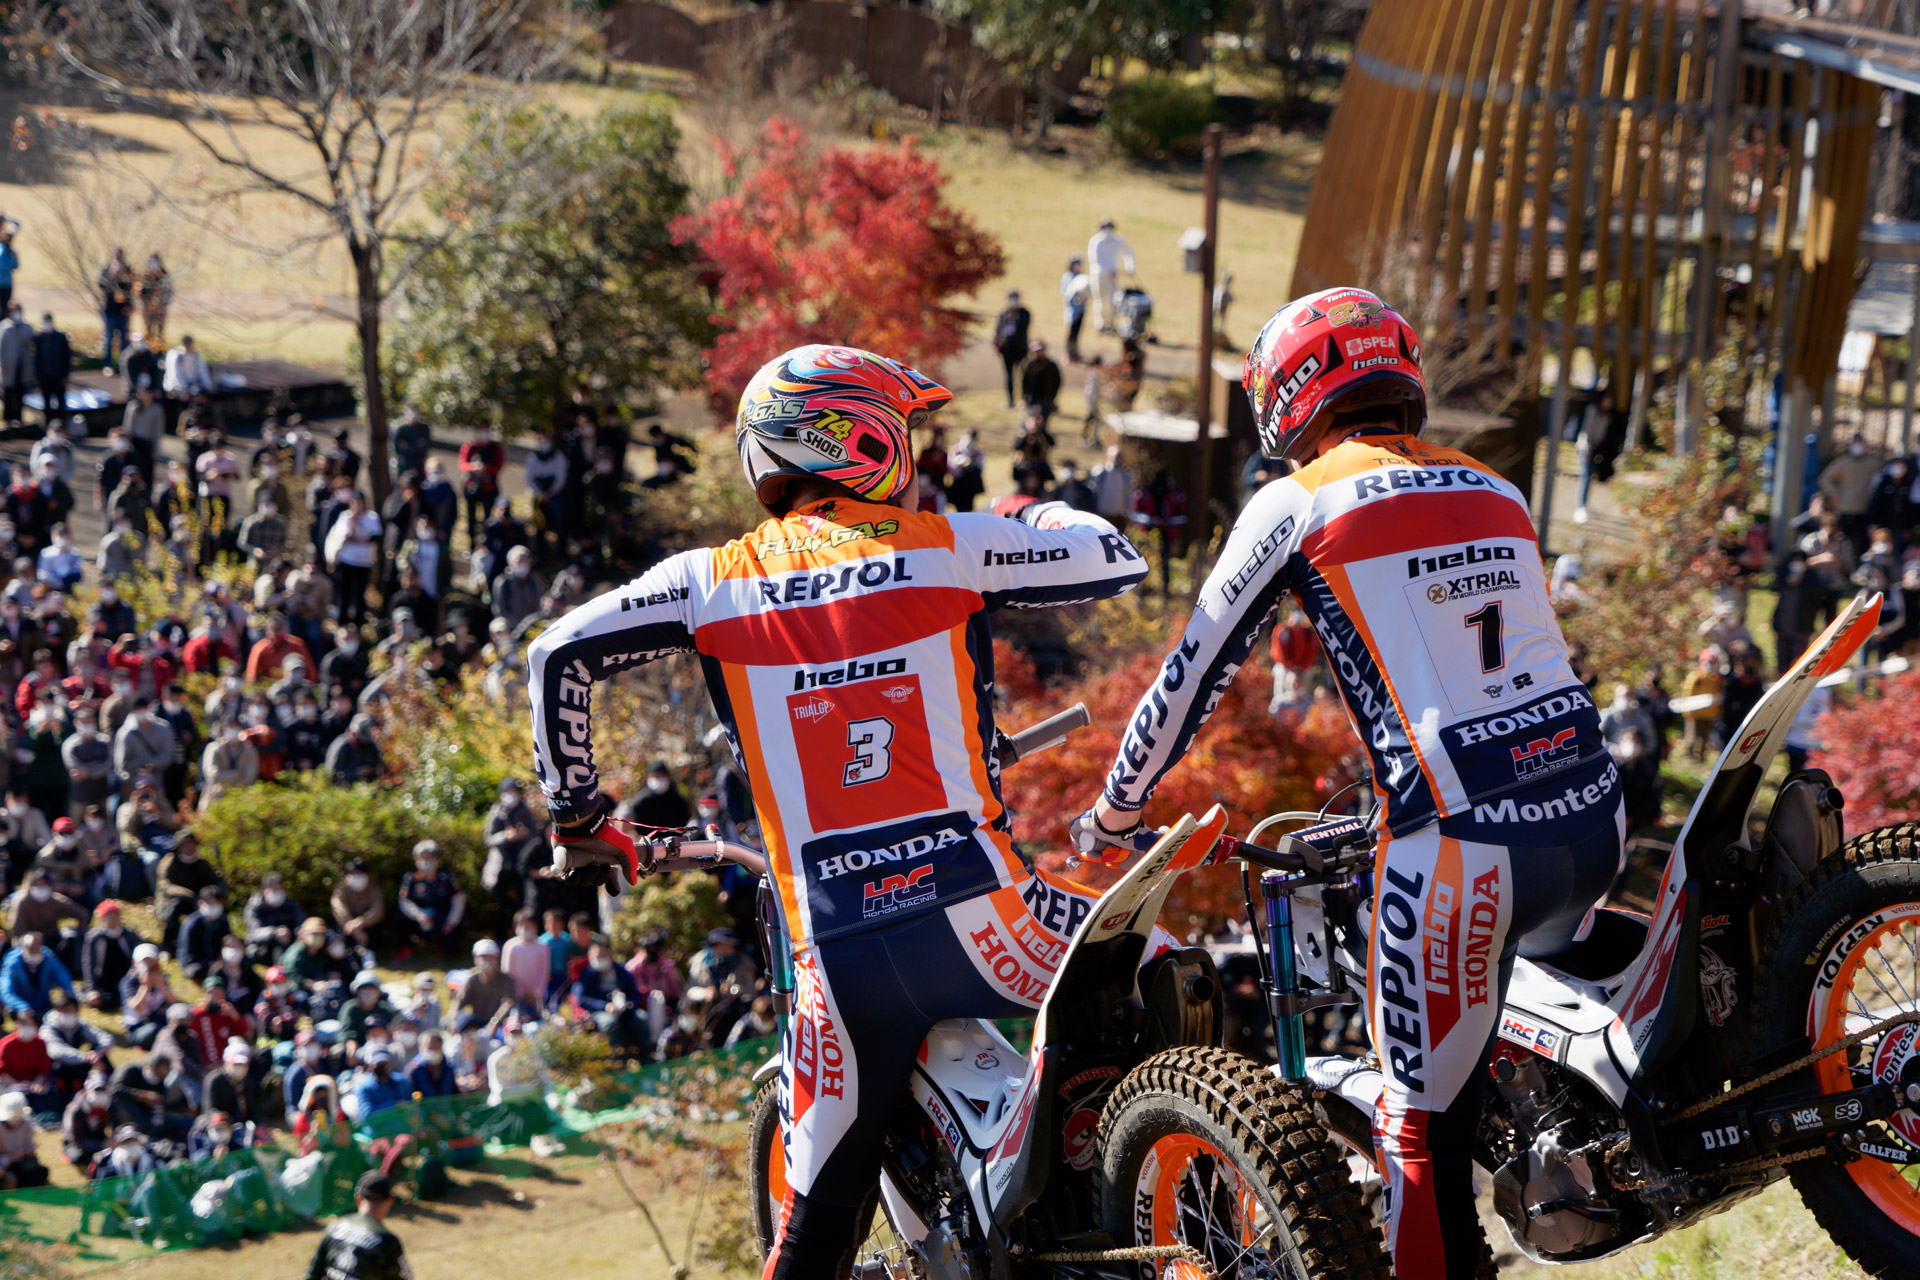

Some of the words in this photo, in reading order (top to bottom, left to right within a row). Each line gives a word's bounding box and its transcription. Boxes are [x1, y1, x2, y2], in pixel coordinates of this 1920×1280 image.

[1362, 336, 1395, 349] SPEA
[1352, 354, 1399, 371] hebo
[1265, 354, 1322, 449] hebo
[813, 407, 855, 442] 74
[803, 429, 843, 460] SHOEI
[1373, 458, 1417, 466] TONI
[1423, 458, 1463, 466] BOU
[1354, 469, 1501, 500] REPSOL
[984, 548, 1070, 567] hebo
[1221, 515, 1296, 606] hebo
[1408, 545, 1516, 579] hebo
[760, 557, 912, 606] REPSOL
[1459, 589, 1479, 599] WORLD
[1481, 584, 1521, 595] CHAMPIONSHIP
[1464, 600, 1505, 675] 1
[794, 658, 906, 691] hebo
[1111, 634, 1200, 802] REPSOL
[1314, 612, 1403, 792] HONDA
[1455, 690, 1593, 747] HONDA
[841, 716, 896, 789] 3
[1510, 726, 1579, 776] HRC
[1517, 767, 1549, 782] Honda
[1549, 756, 1579, 771] RACING
[1110, 794, 1140, 809] HONDA
[1474, 760, 1618, 824] Montesa
[1302, 821, 1364, 843] RENTHAL
[816, 827, 967, 881] HONDA
[862, 863, 936, 914] HRC
[863, 907, 898, 920] Honda
[899, 894, 937, 911] RACING
[1023, 876, 1092, 938] REP
[1890, 904, 1920, 914] ONDA
[1425, 880, 1454, 996] hebo
[1464, 864, 1500, 1009] HONDA
[1815, 914, 1852, 951] MICHELIN
[1816, 914, 1885, 990] REPSOL
[1379, 865, 1425, 1094] REPSOL
[1503, 1019, 1535, 1041] HRC
[1539, 1033, 1556, 1048] 40
[1057, 1065, 1122, 1100] FUJIGAS
[927, 1096, 948, 1128] HRC
[1791, 1107, 1822, 1126] NGK
[948, 1127, 958, 1144] 40
[1859, 1141, 1908, 1162] GALFER
[1140, 1155, 1156, 1181] HONDA
